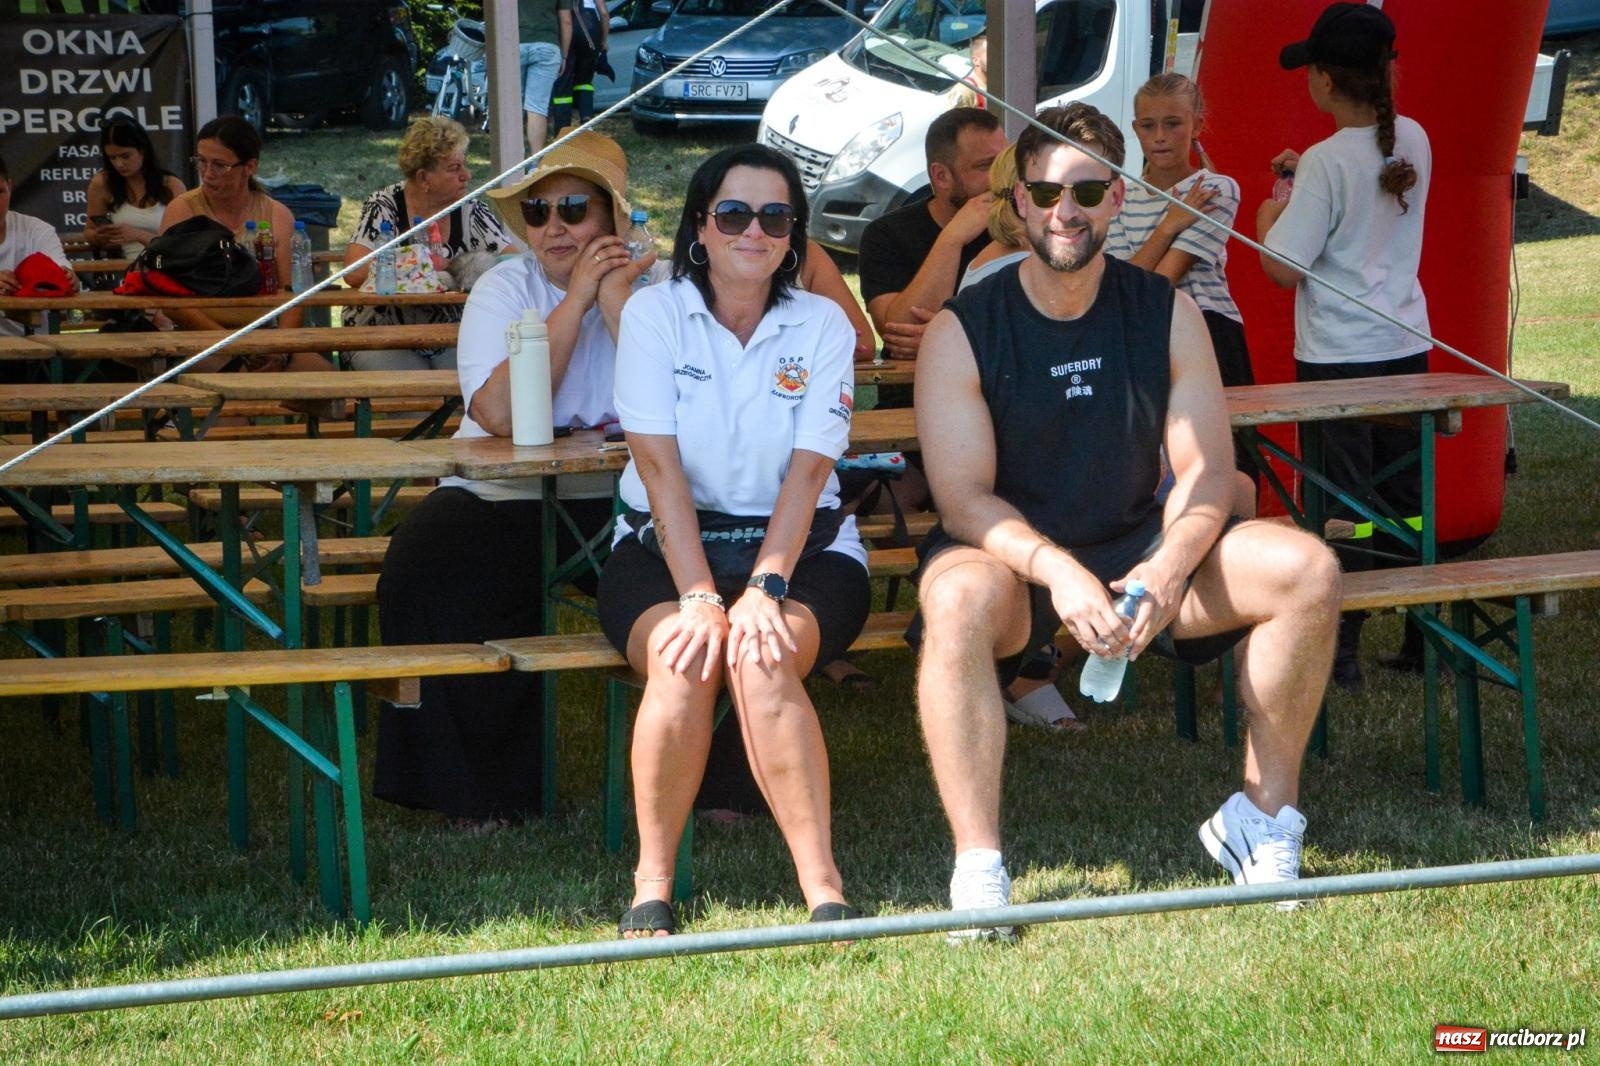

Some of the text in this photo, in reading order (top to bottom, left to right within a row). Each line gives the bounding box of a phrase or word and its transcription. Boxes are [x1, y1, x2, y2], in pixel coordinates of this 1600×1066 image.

[22, 28, 146, 56] OKNA
[19, 67, 152, 95] DRZWI
[691, 84, 744, 97] SRC FV73
